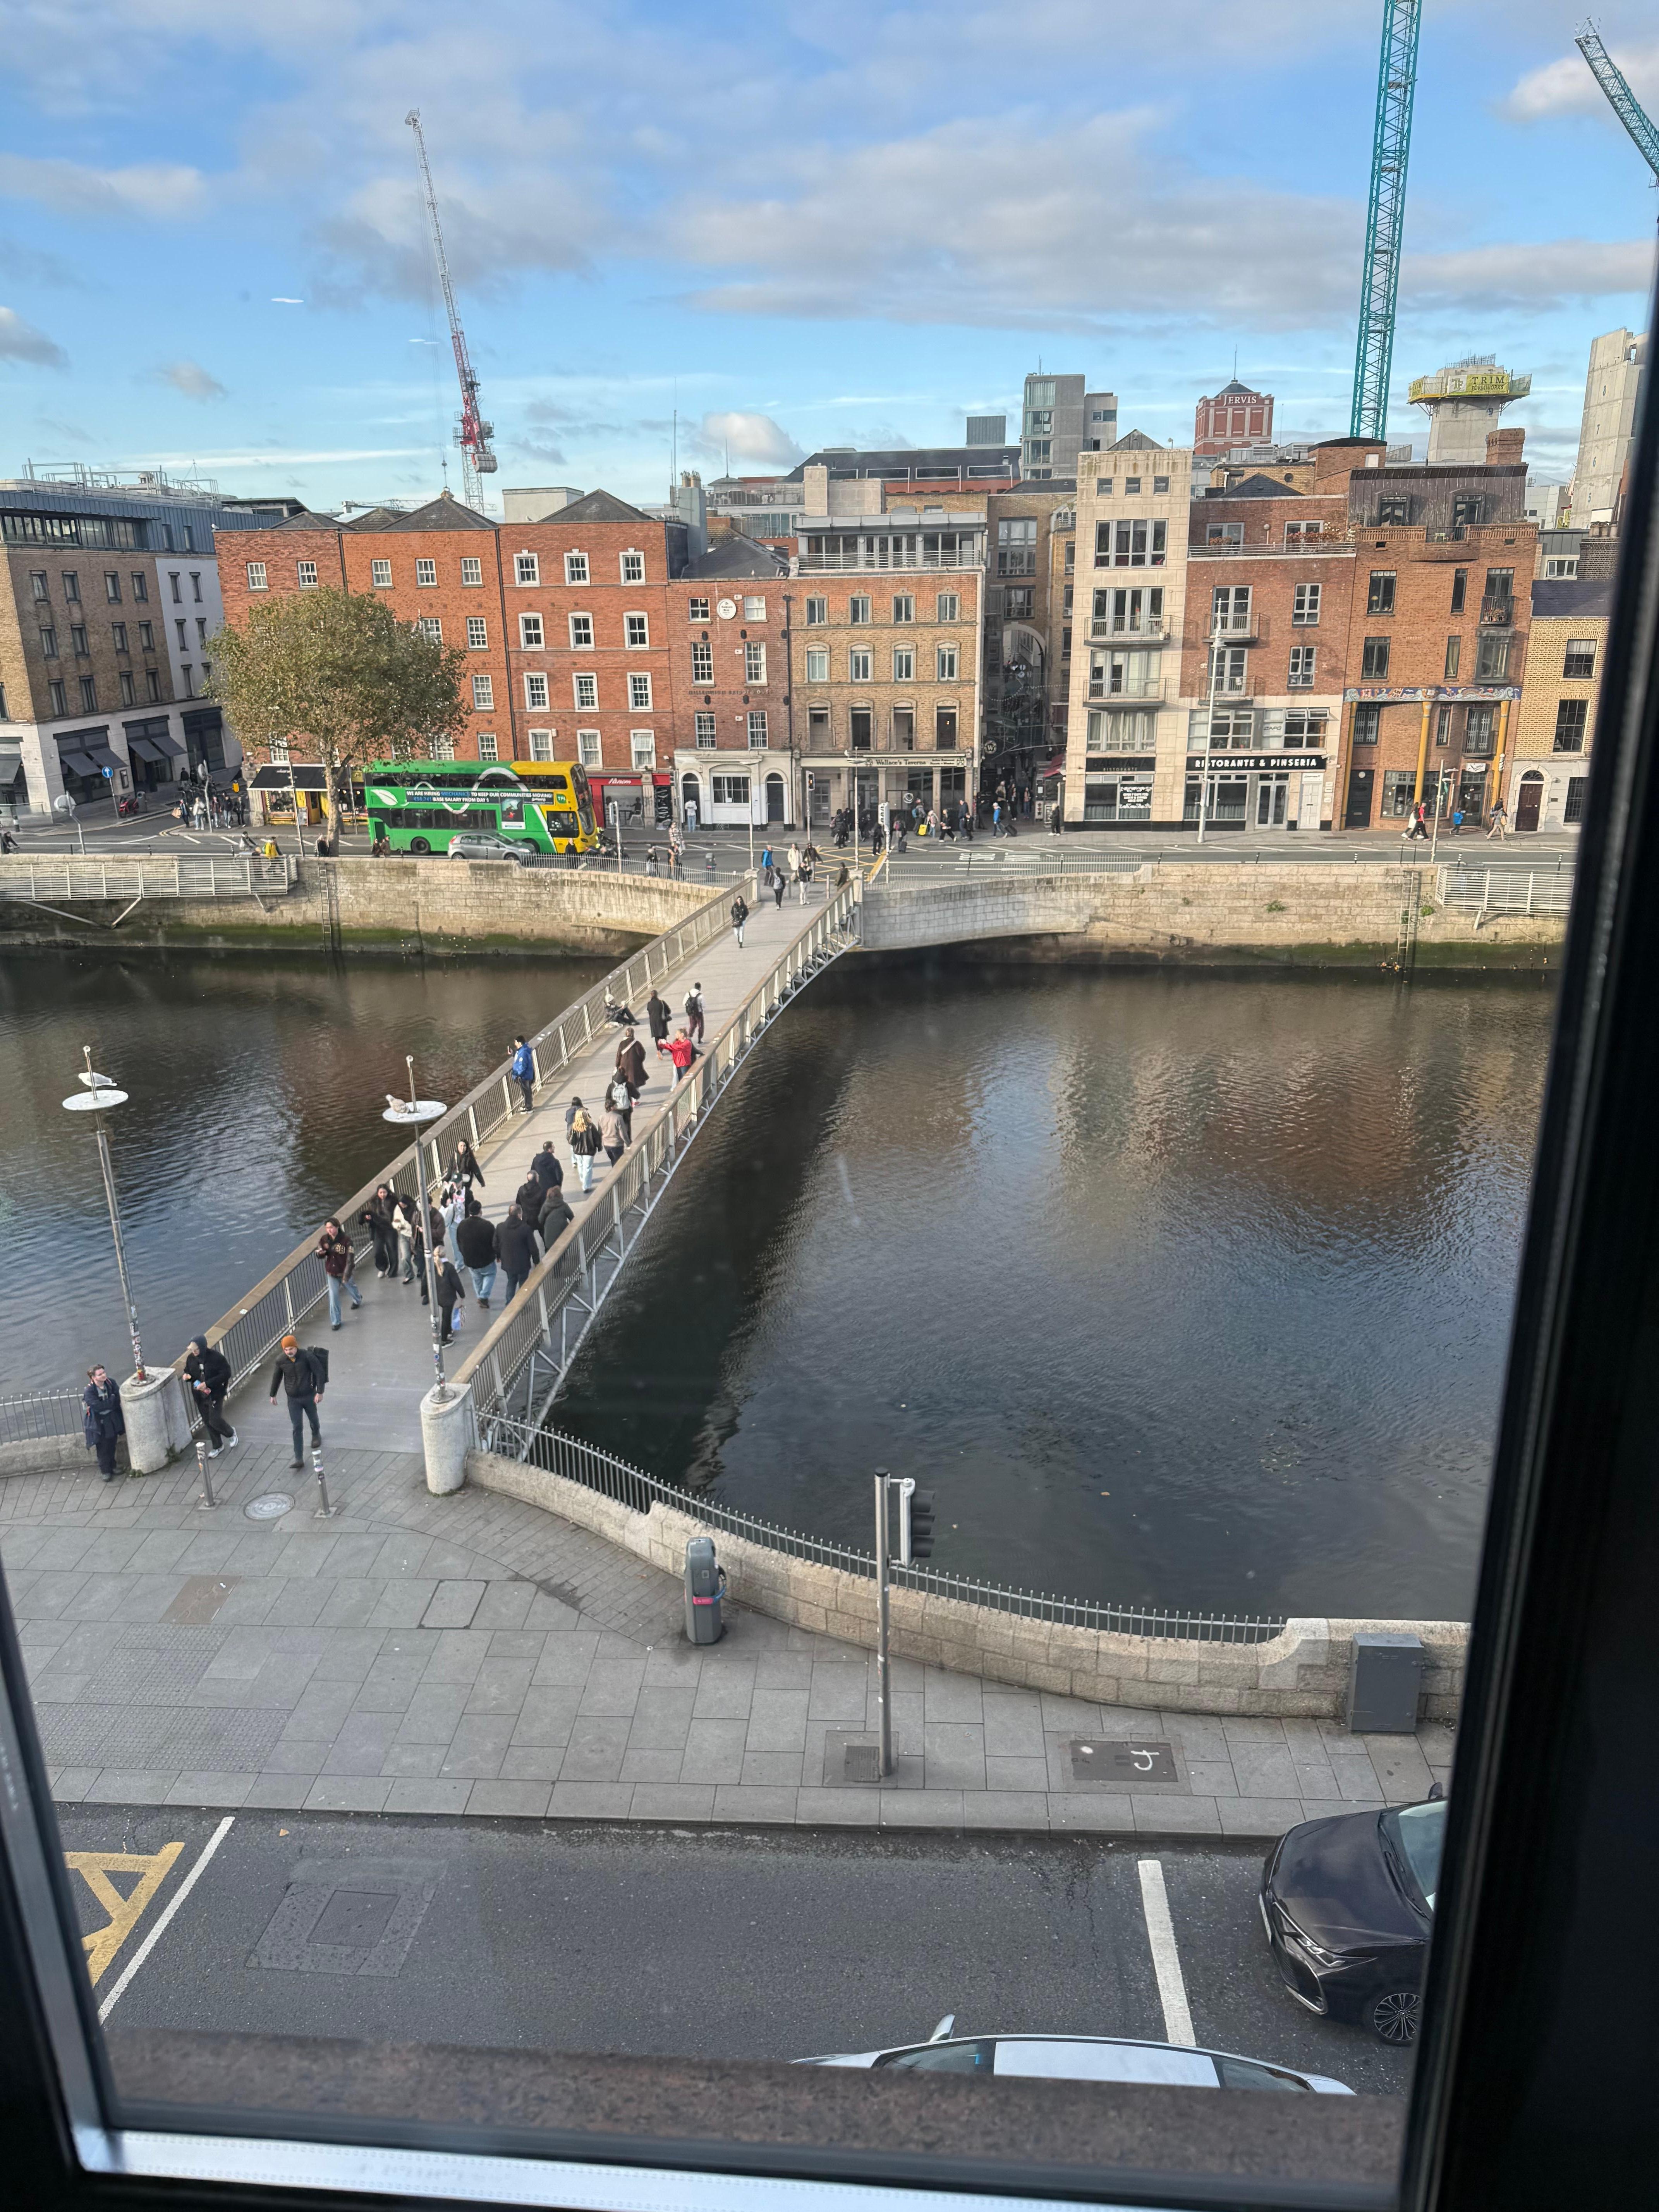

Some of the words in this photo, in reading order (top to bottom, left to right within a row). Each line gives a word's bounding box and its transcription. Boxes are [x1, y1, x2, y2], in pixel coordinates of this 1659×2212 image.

[1472, 376, 1504, 384] TRIM
[1602, 385, 1607, 396] 8
[1223, 395, 1257, 406] JERVIS
[1597, 424, 1600, 434] 7
[1593, 457, 1597, 467] 6
[1588, 492, 1592, 503] 5
[1195, 759, 1255, 768] RITORANTE
[1259, 759, 1266, 767] &
[1271, 757, 1317, 767] PINSERIA
